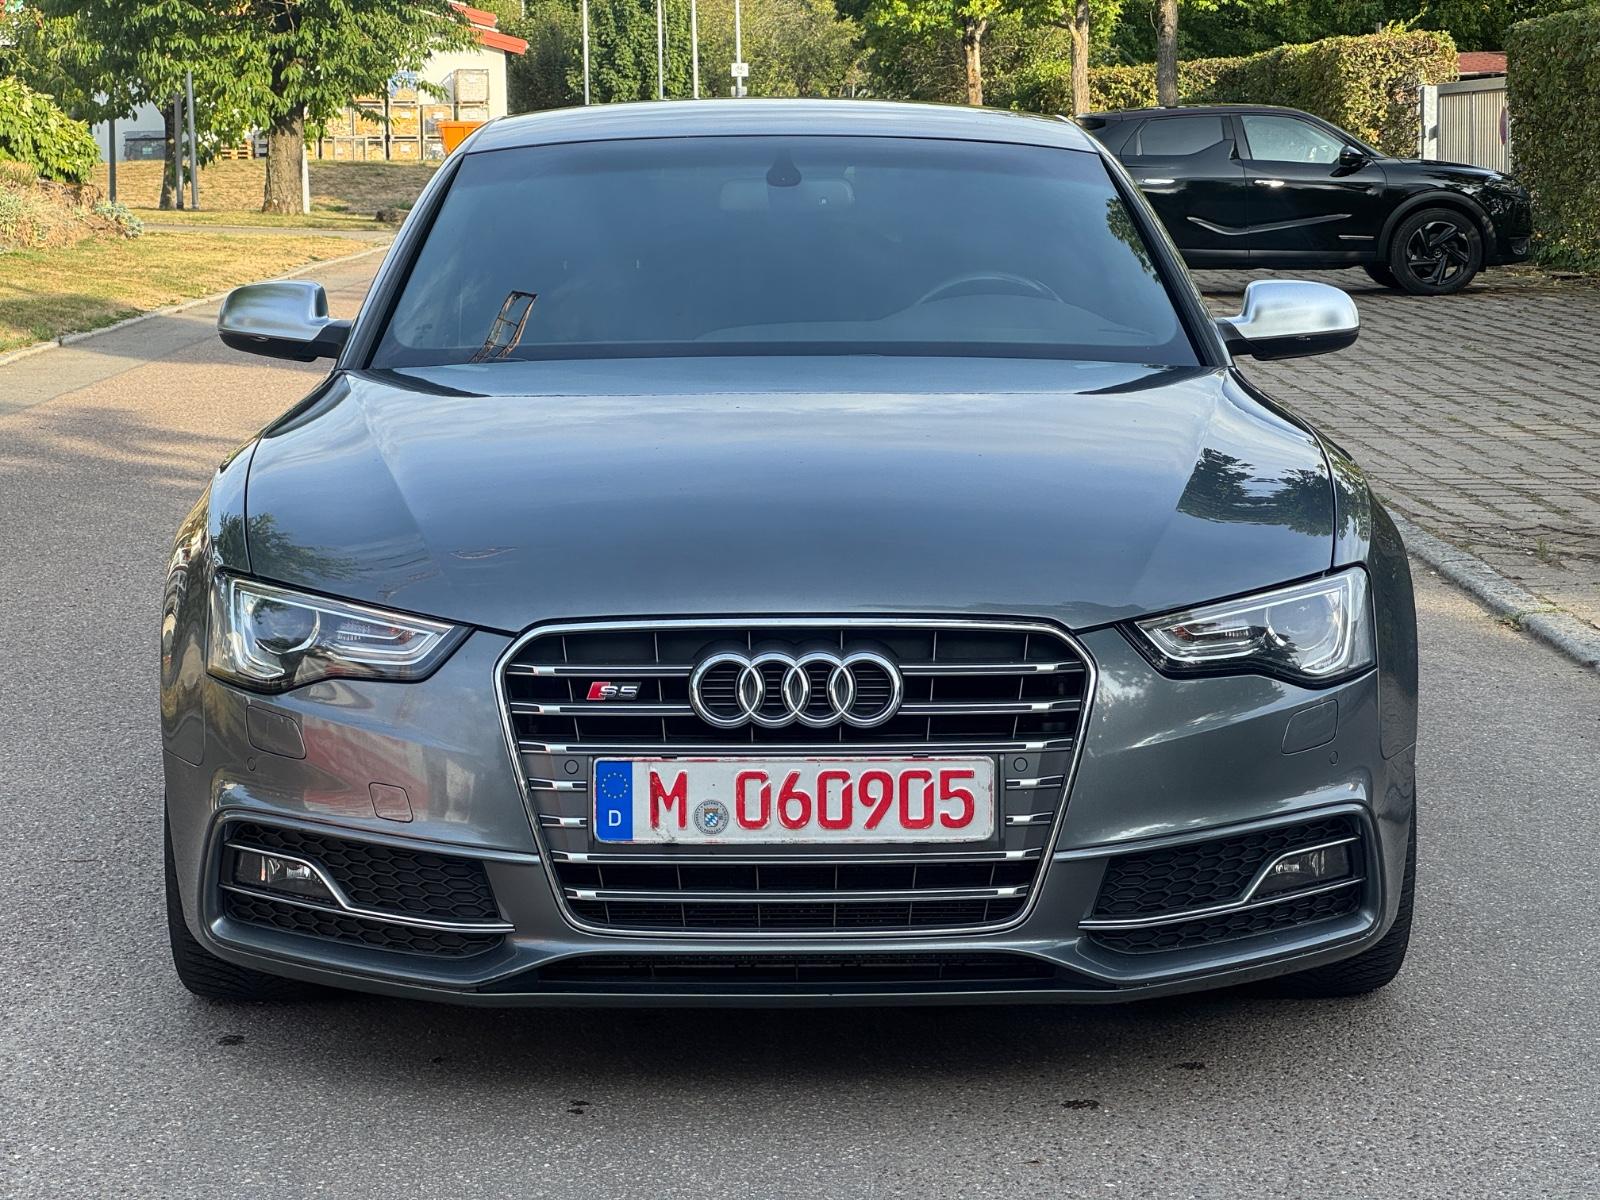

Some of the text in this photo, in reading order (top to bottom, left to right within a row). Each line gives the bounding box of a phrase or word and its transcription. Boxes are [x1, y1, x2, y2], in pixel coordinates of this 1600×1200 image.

[598, 685, 638, 698] S5
[649, 770, 687, 829] M
[735, 770, 975, 830] 060905
[608, 809, 622, 827] D
